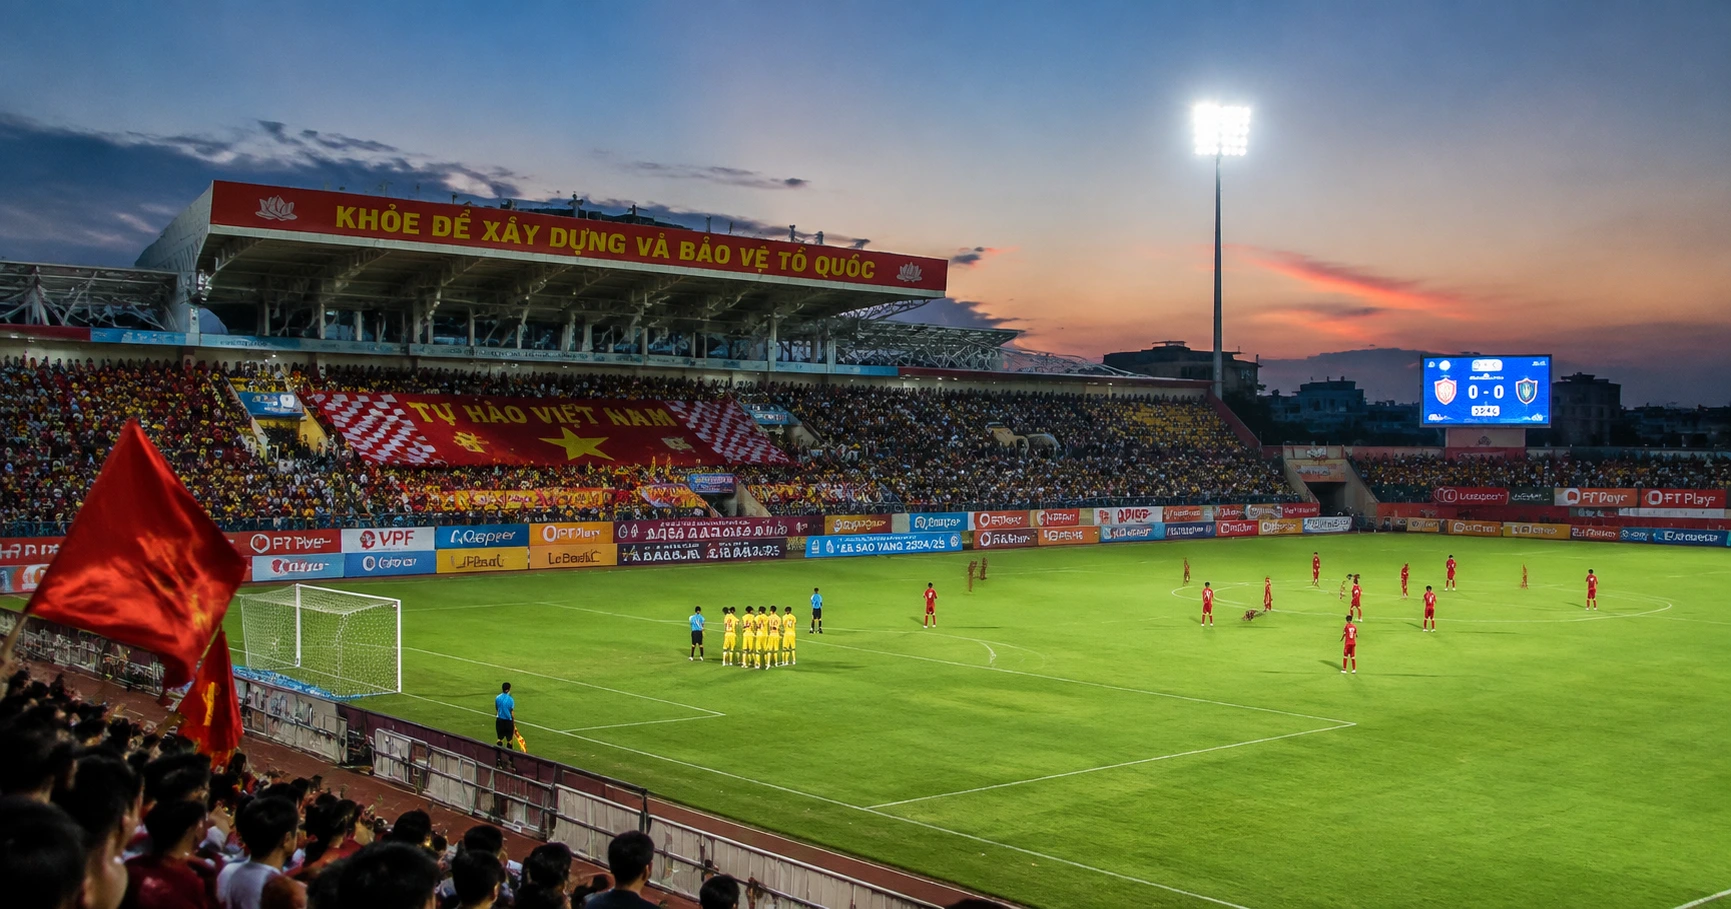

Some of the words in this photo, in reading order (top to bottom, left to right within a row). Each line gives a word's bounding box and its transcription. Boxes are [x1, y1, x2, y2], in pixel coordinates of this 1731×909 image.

[336, 203, 420, 235] KHỎE
[549, 226, 627, 256] DỰNG
[679, 236, 731, 265] BẢO
[1468, 384, 1479, 400] 0
[1493, 384, 1505, 400] 0
[603, 407, 678, 427] NAM
[378, 530, 416, 546] VPF
